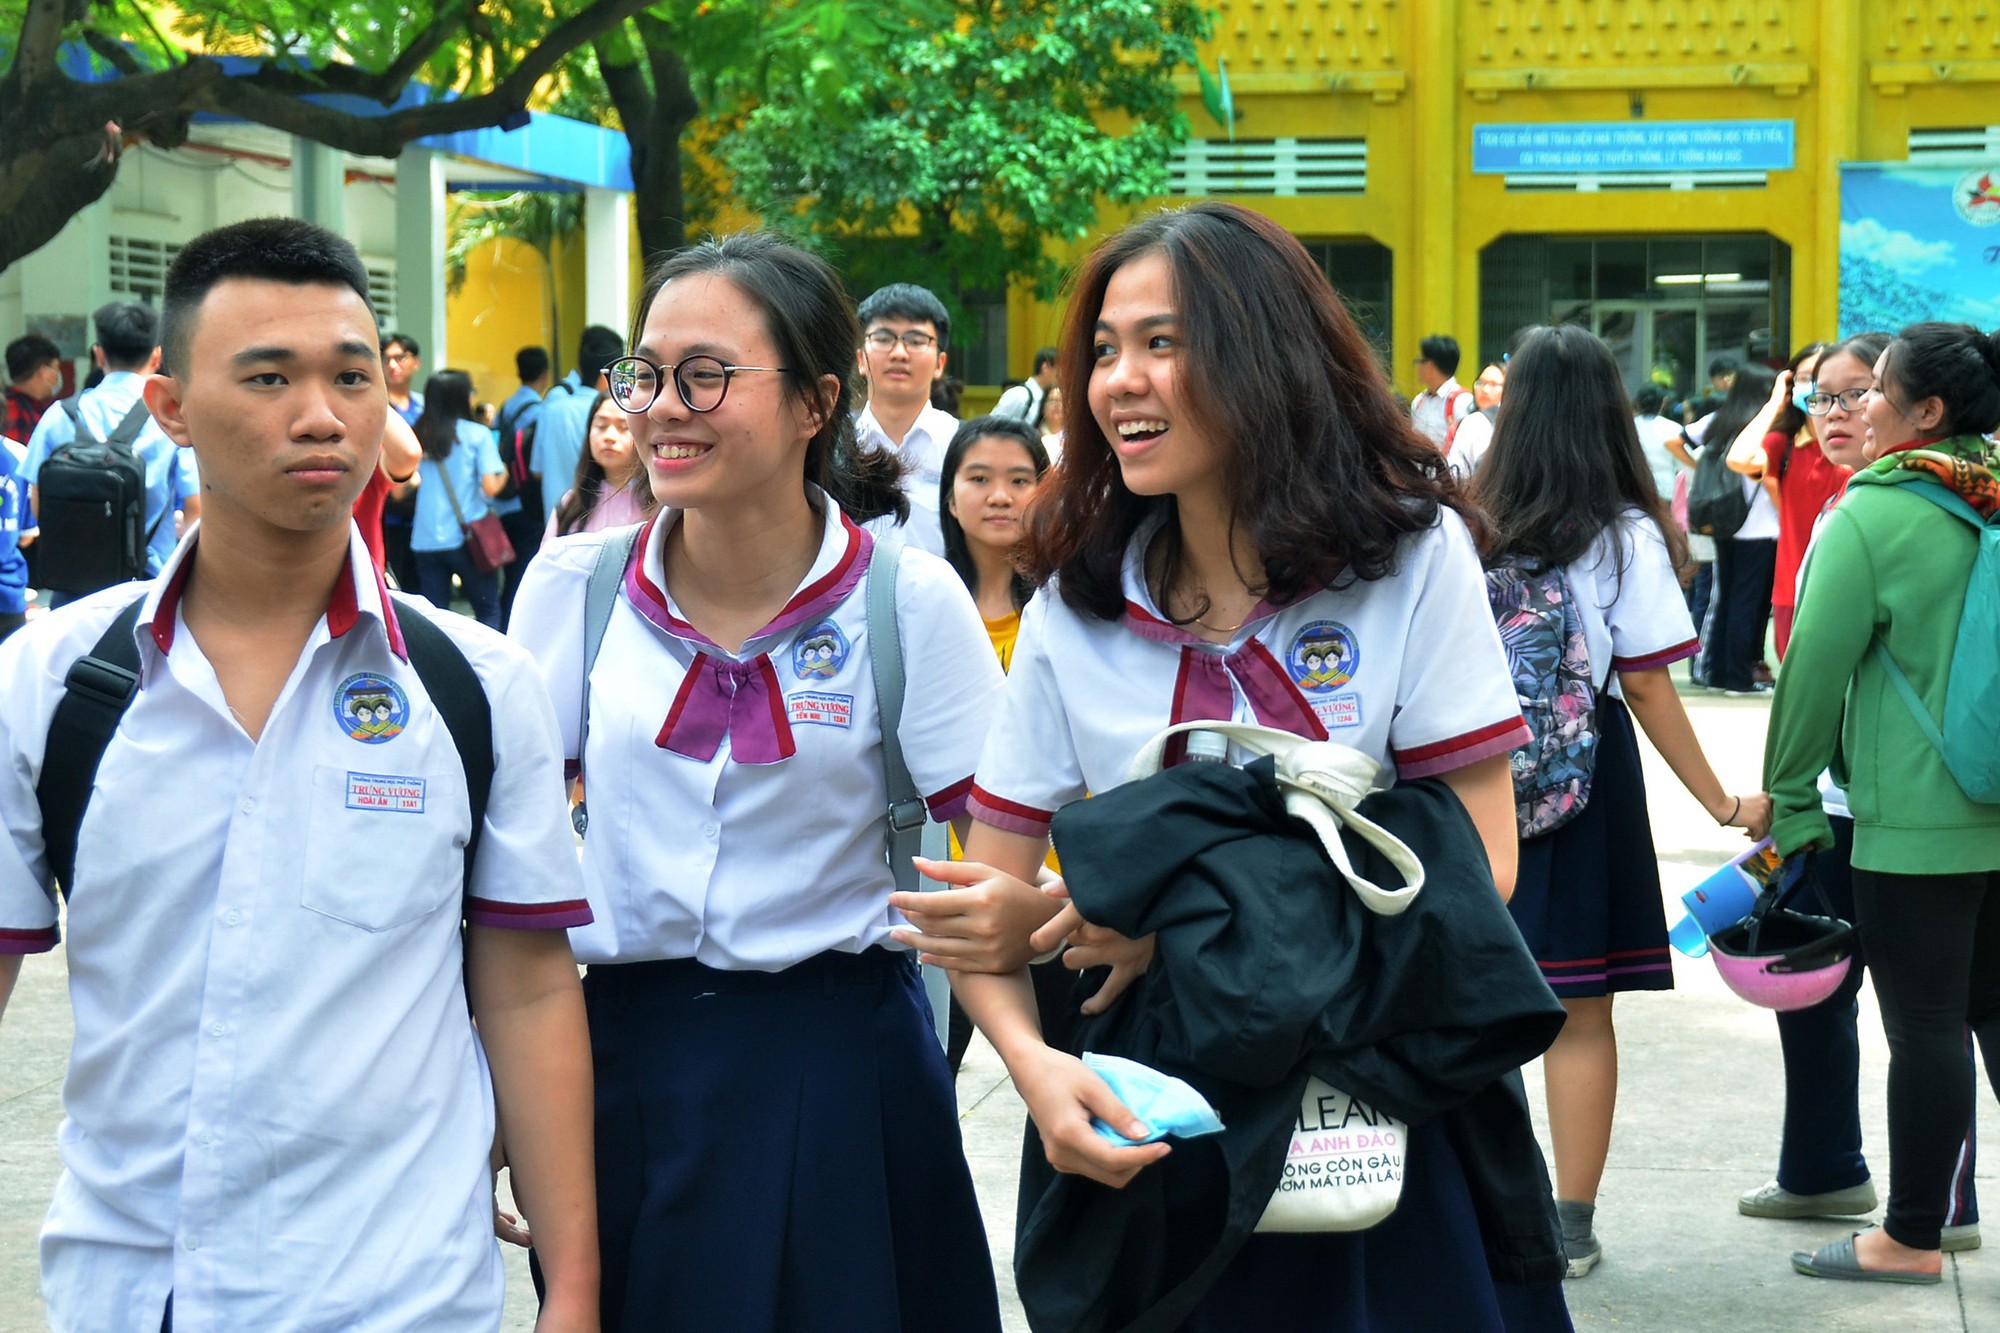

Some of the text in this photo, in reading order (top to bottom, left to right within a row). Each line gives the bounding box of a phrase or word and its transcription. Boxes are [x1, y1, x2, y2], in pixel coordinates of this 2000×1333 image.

[791, 700, 849, 714] TRƯNG VƯƠNG
[1322, 702, 1356, 714] VƯƠNG
[352, 784, 420, 798] TRƯNG VƯƠNG
[402, 800, 418, 808] 11A1
[1296, 1095, 1393, 1132] LEA
[1310, 1135, 1350, 1153] ANH
[1357, 1129, 1396, 1148] ĐÀO
[1284, 1162, 1322, 1178] ÔNG
[1326, 1157, 1363, 1173] CÒN
[1310, 1174, 1341, 1189] MÁT
